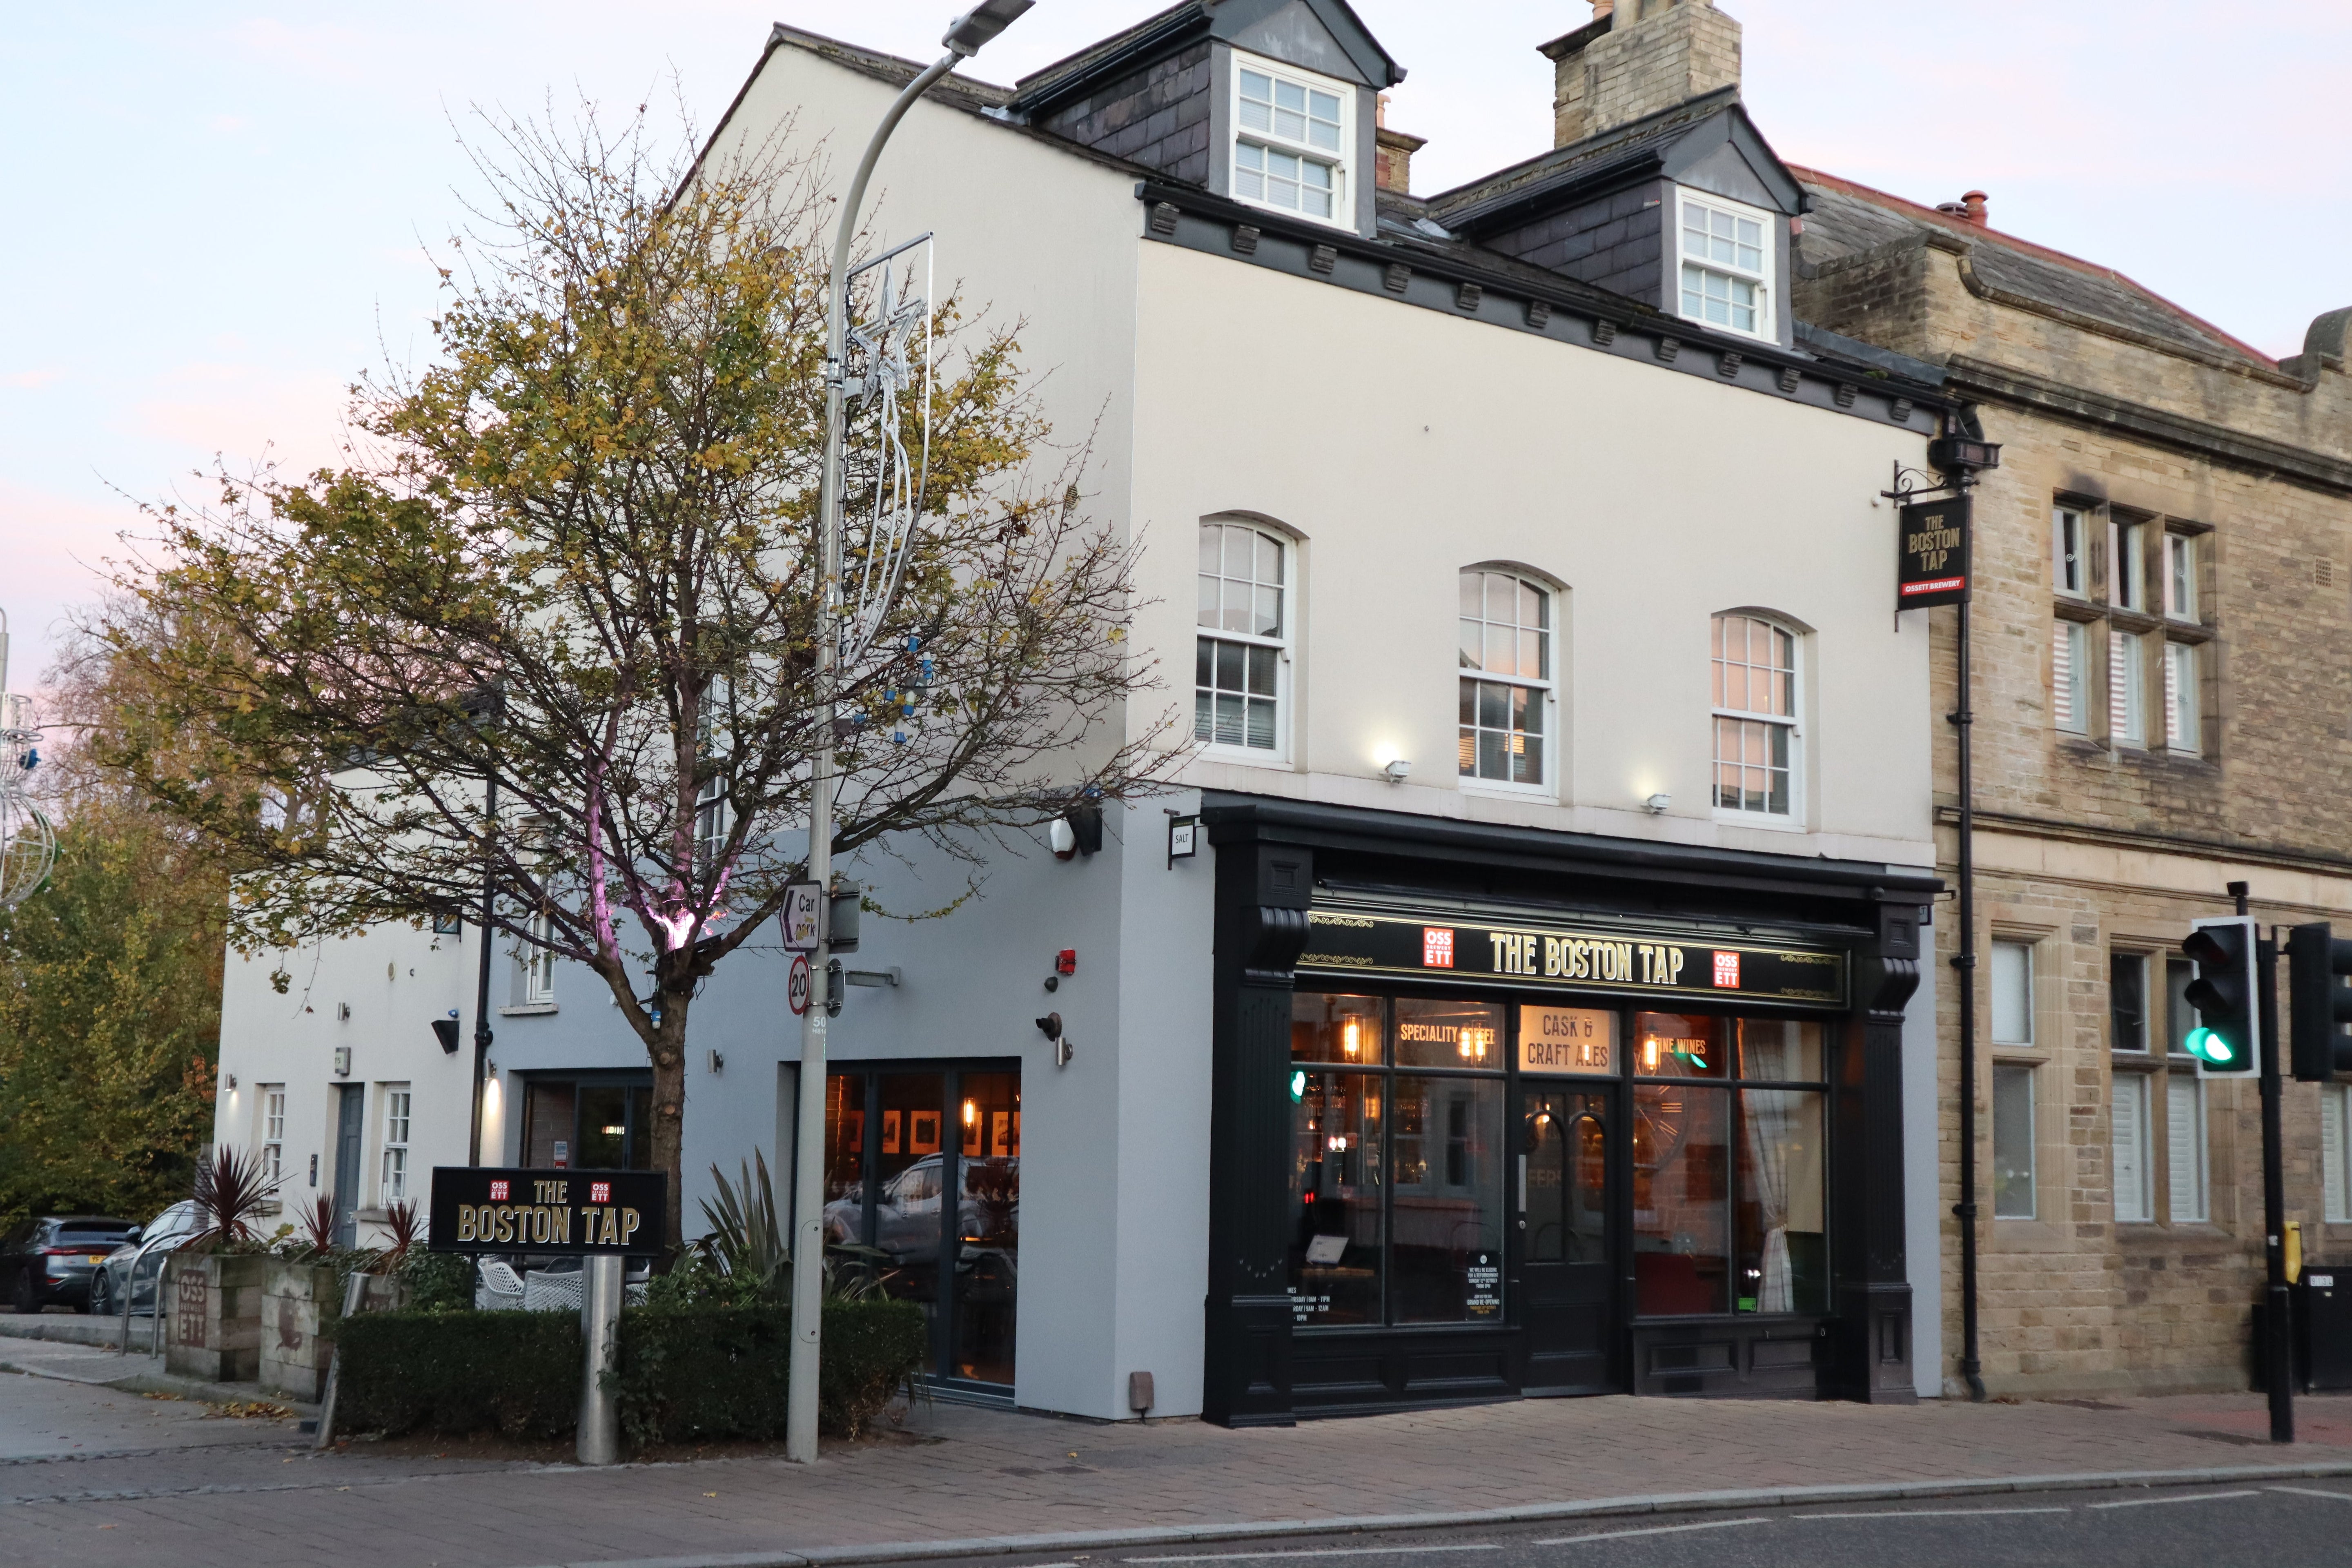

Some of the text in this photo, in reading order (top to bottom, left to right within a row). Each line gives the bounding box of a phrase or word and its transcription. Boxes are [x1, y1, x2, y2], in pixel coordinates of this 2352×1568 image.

[1924, 514, 1944, 531] THE
[1909, 528, 1960, 553] BOSTON
[1921, 550, 1948, 571] TAP
[1905, 579, 1961, 592] OSSETT BREWERY
[1176, 833, 1189, 844] SALT
[799, 894, 815, 912] Car
[1426, 931, 1452, 945] OSS
[1426, 950, 1451, 964] ETT
[1490, 933, 1684, 984] THE BOSTON TAP
[1716, 954, 1737, 968] OSS
[791, 973, 806, 997] 20
[1716, 971, 1737, 985] ETT
[813, 1016, 826, 1027] 50
[1544, 1014, 1578, 1037] CASK
[1401, 1024, 1458, 1043] SPECIALITY
[1528, 1043, 1570, 1065] CRAFT
[1677, 1038, 1706, 1054] WINES
[534, 1180, 568, 1203] THE
[457, 1205, 639, 1245] BOSTON TAP
[180, 1275, 204, 1302] OSS
[180, 1314, 204, 1340] ETT
